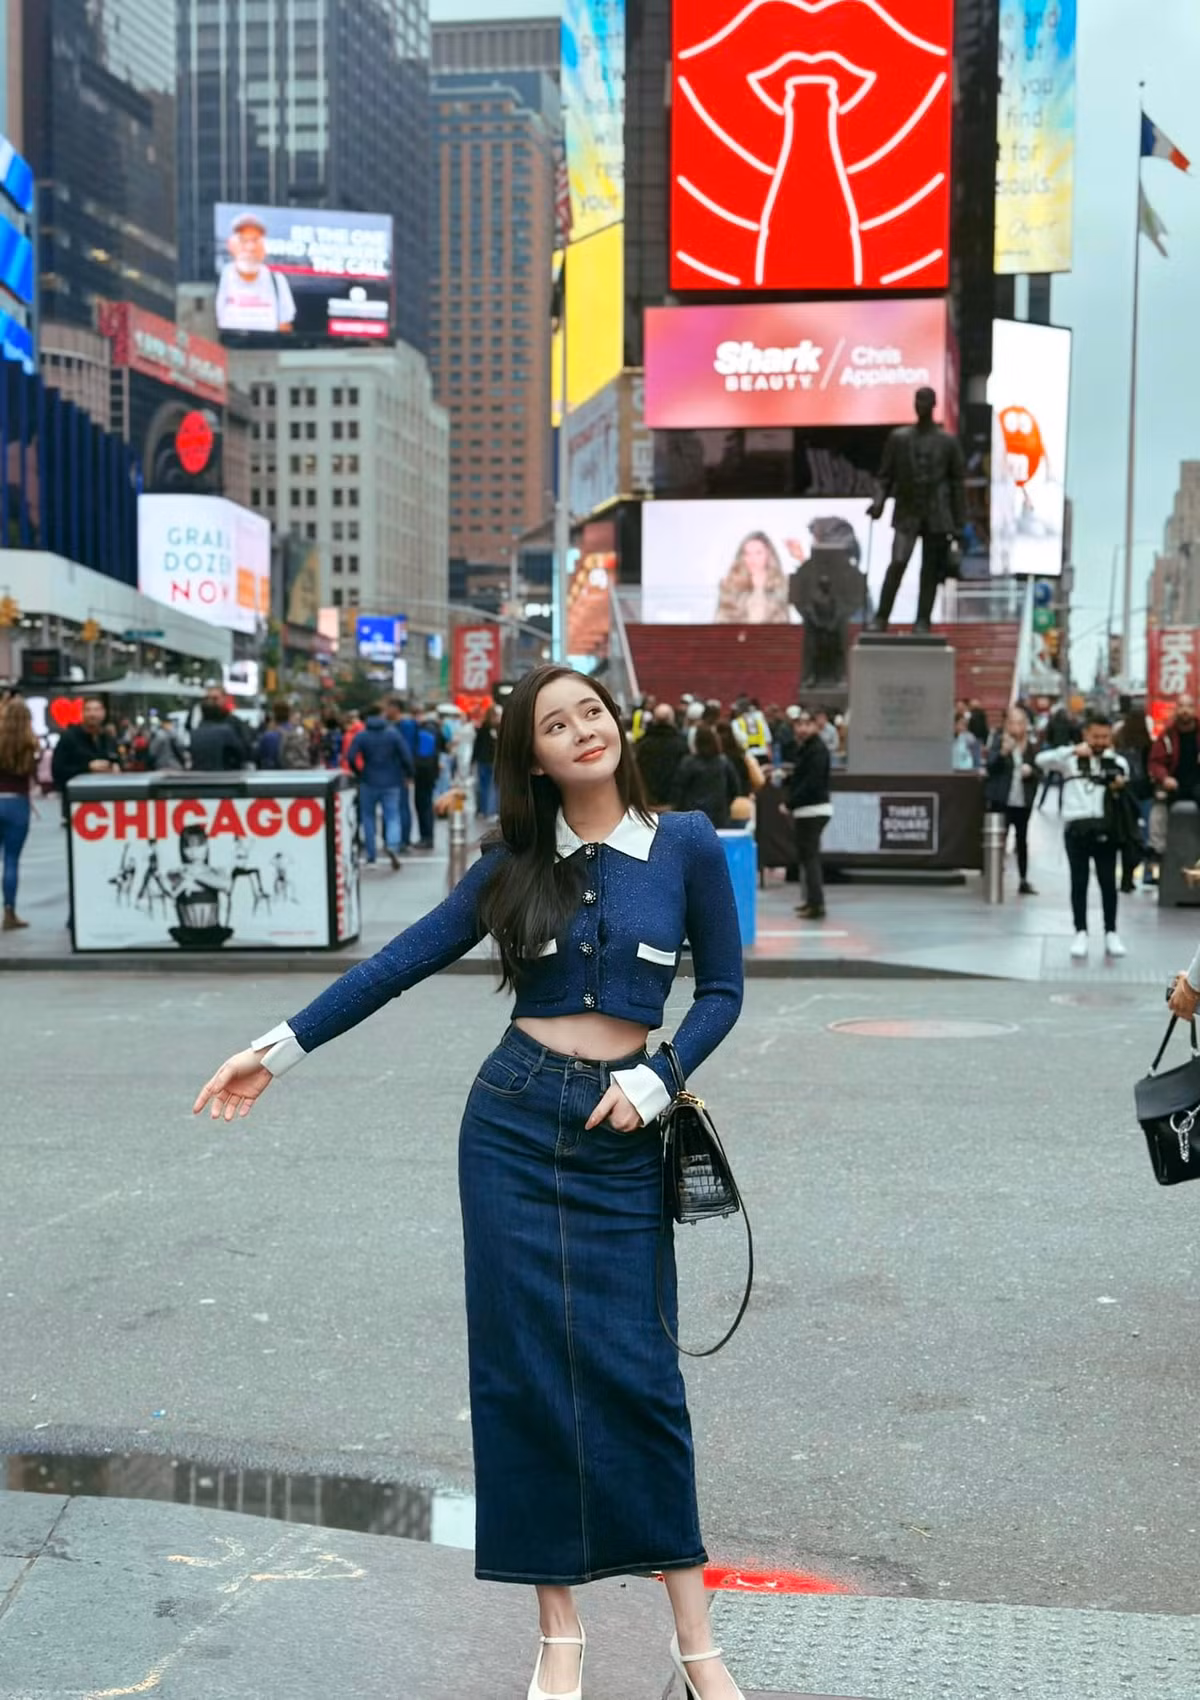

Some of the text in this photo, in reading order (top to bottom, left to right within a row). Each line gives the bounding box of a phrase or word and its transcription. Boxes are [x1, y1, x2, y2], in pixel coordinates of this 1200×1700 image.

[713, 339, 824, 375] Shark
[850, 345, 902, 366] Chris
[724, 374, 814, 392] BEAUTY
[839, 365, 929, 389] Appleton
[464, 629, 494, 691] tkts
[1159, 632, 1195, 695] tkts
[72, 796, 325, 841] CHICAGO
[887, 805, 928, 818] TIMES
[882, 818, 931, 832] SQUARE
